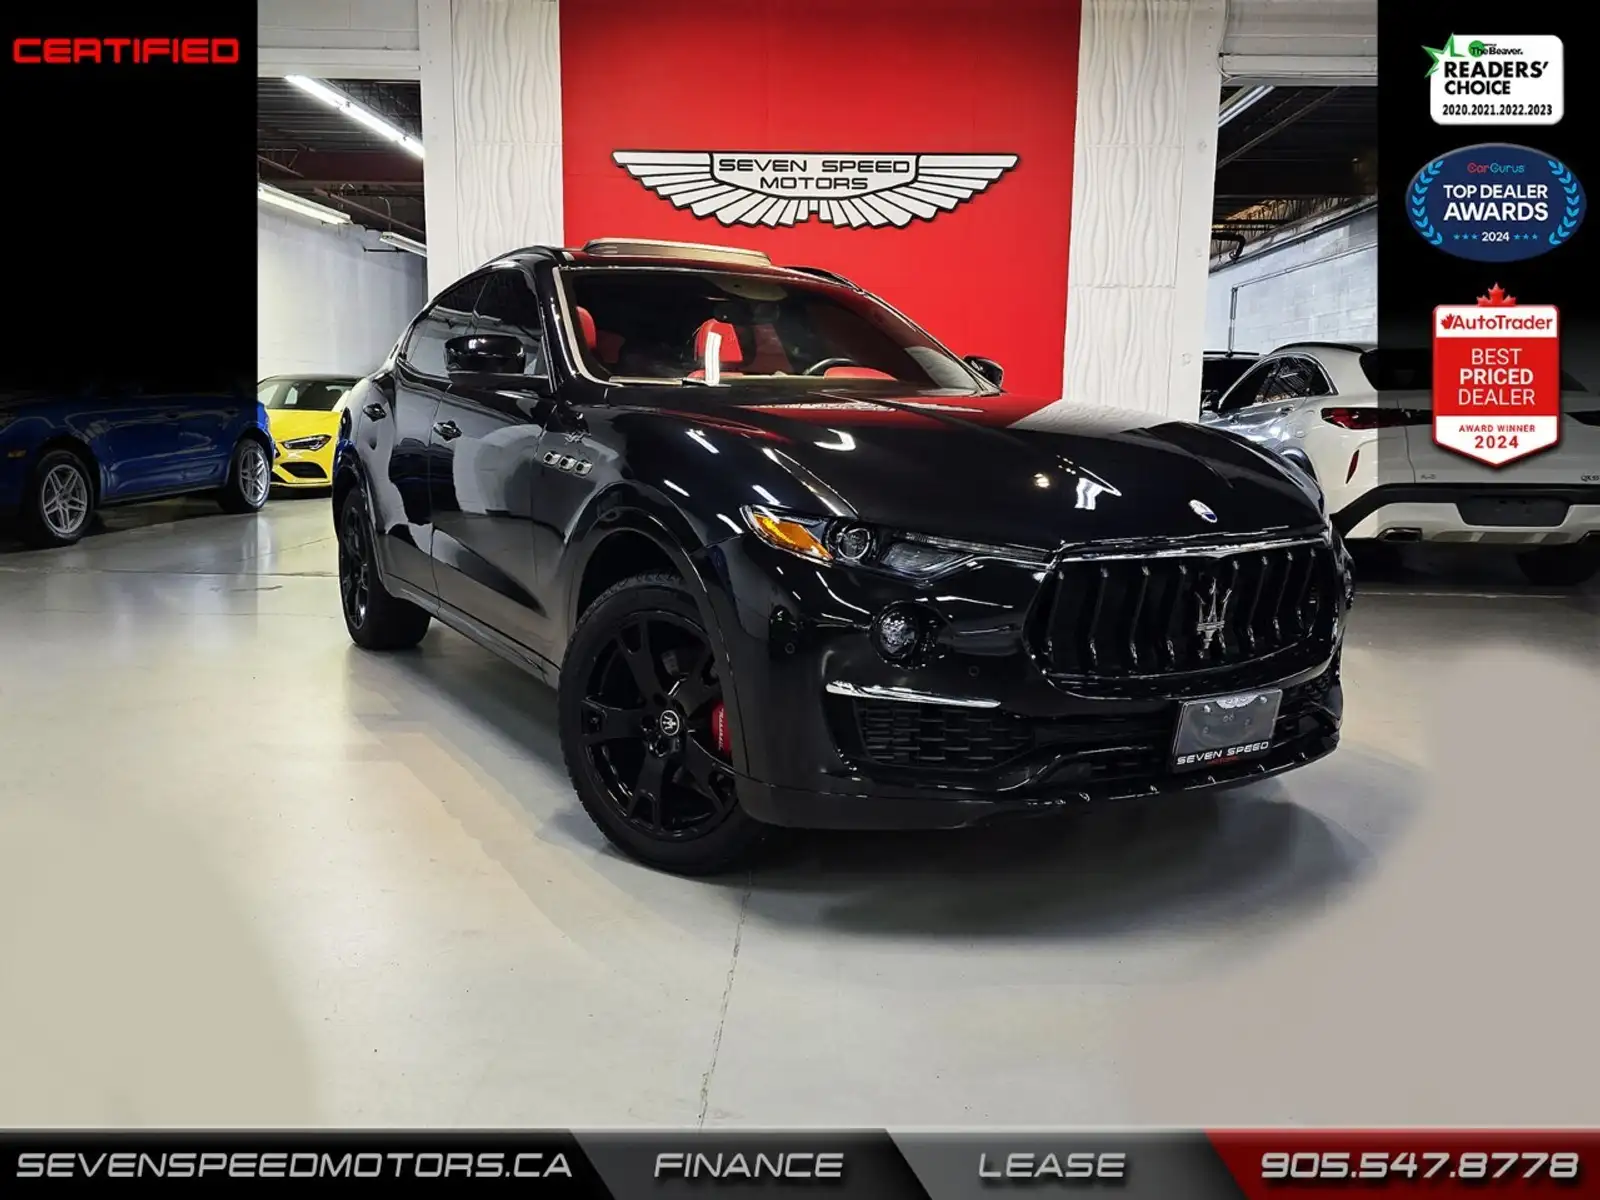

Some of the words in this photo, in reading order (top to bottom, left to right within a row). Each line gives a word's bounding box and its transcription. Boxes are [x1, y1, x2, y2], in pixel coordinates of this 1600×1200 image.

[719, 158, 808, 173] SEVEN
[821, 160, 910, 174] SPEED
[760, 177, 869, 190] MOTORS
[1176, 750, 1222, 765] SEVEN
[1227, 741, 1269, 756] SPEED
